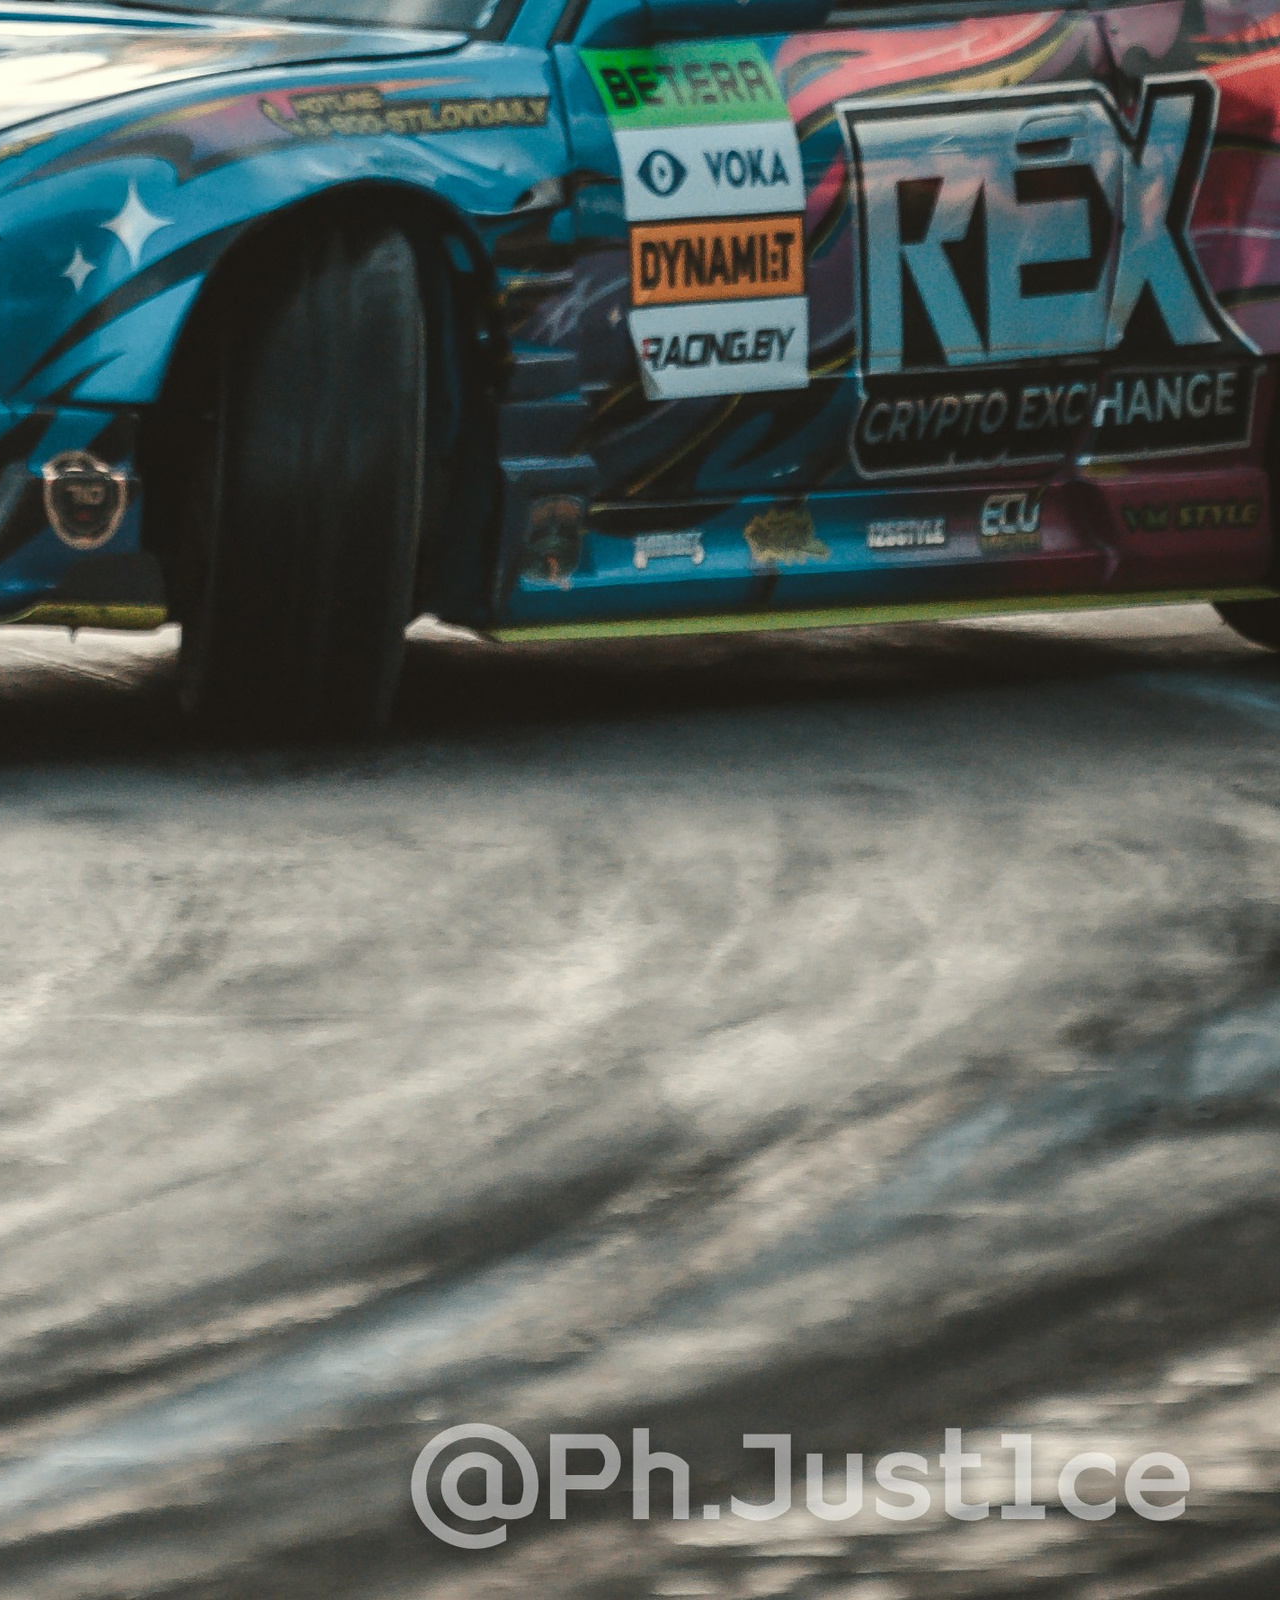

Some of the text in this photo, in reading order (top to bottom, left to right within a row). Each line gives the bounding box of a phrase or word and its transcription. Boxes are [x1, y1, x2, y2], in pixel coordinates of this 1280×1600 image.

[703, 148, 790, 189] VOKA
[852, 94, 1222, 374] REX
[862, 371, 1238, 445] CRYPTO EXCHANGE
[981, 493, 1041, 536] ECU
[1177, 501, 1259, 527] STYLE
